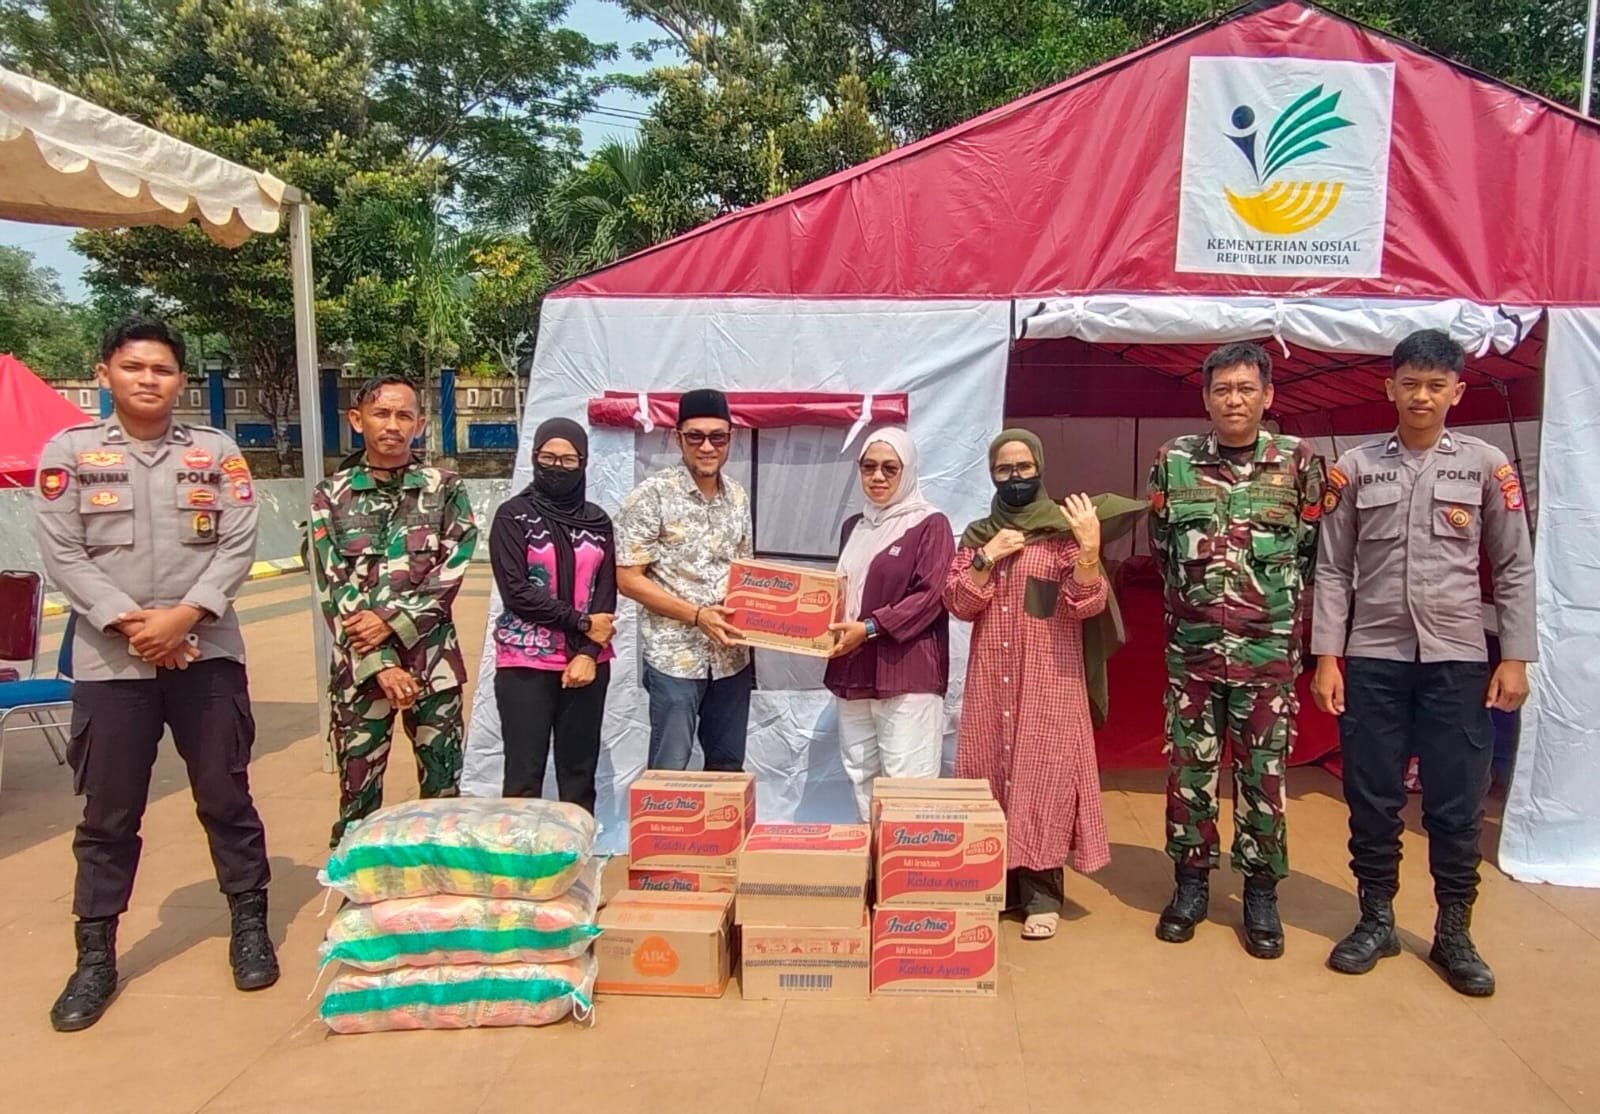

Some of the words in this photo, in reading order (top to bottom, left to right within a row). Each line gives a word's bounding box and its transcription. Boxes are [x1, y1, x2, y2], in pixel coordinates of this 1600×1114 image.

[1207, 238, 1307, 252] KEMENTERIAN
[1311, 240, 1361, 252] SOSIAL
[1217, 252, 1277, 265] REPUBLIK
[1283, 254, 1350, 265] INDONESIA
[1357, 471, 1397, 486] IBNU
[1437, 469, 1482, 482] POLRI
